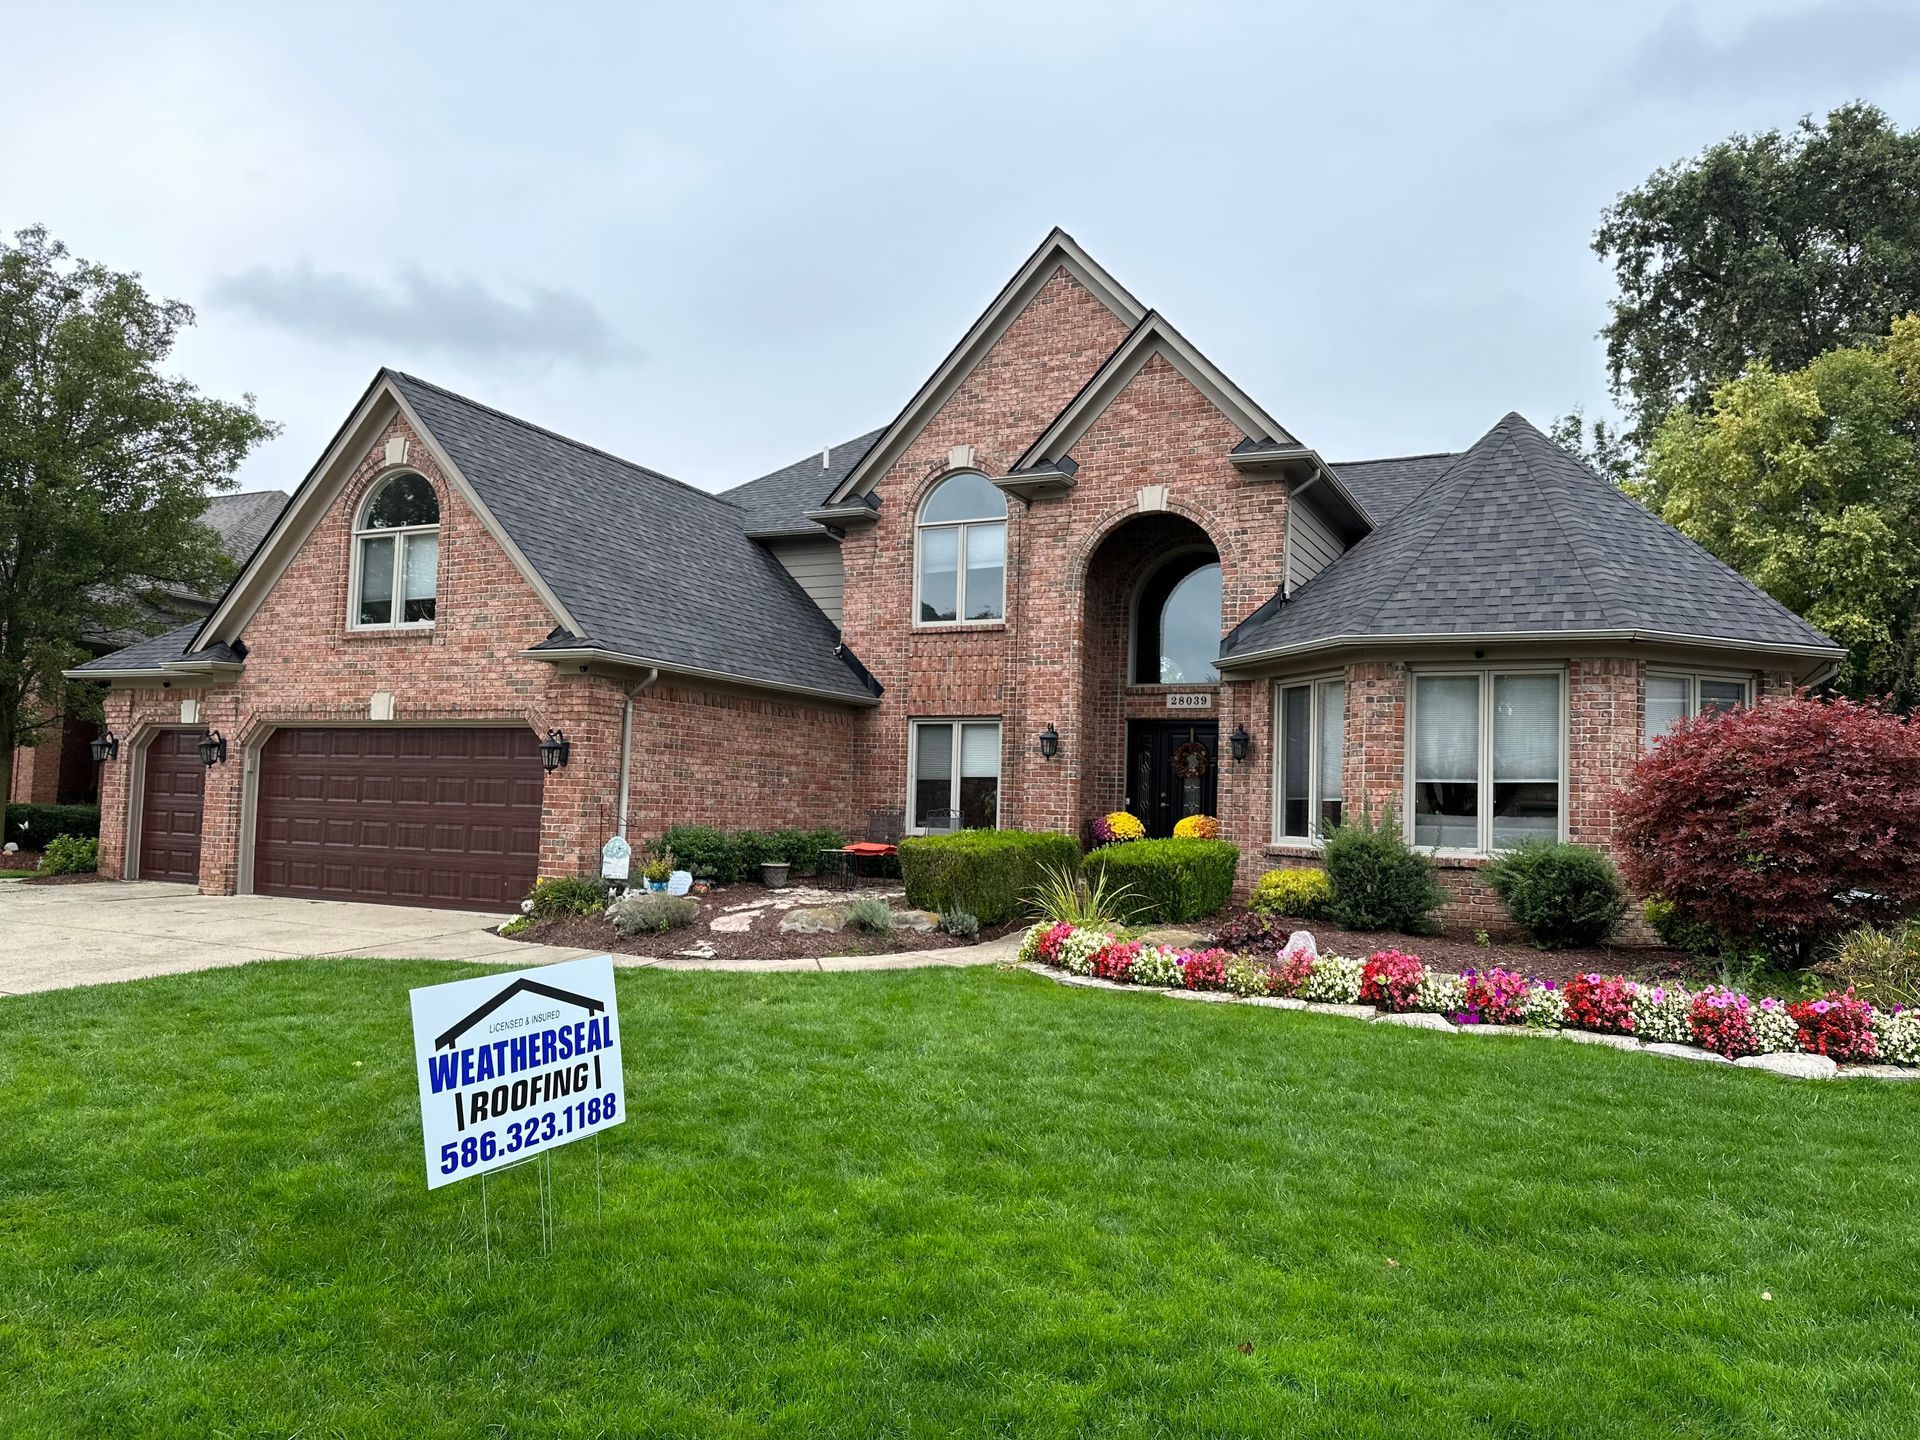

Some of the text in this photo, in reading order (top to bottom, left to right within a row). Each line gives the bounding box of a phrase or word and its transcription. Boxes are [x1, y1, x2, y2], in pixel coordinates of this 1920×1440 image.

[1171, 696, 1207, 705] 28039
[489, 1009, 561, 1034] LICENSED & INSURED
[428, 1015, 613, 1094] WEATHERSEAL
[470, 1062, 588, 1125] ROOFING
[440, 1092, 617, 1175] 586.323.1188
